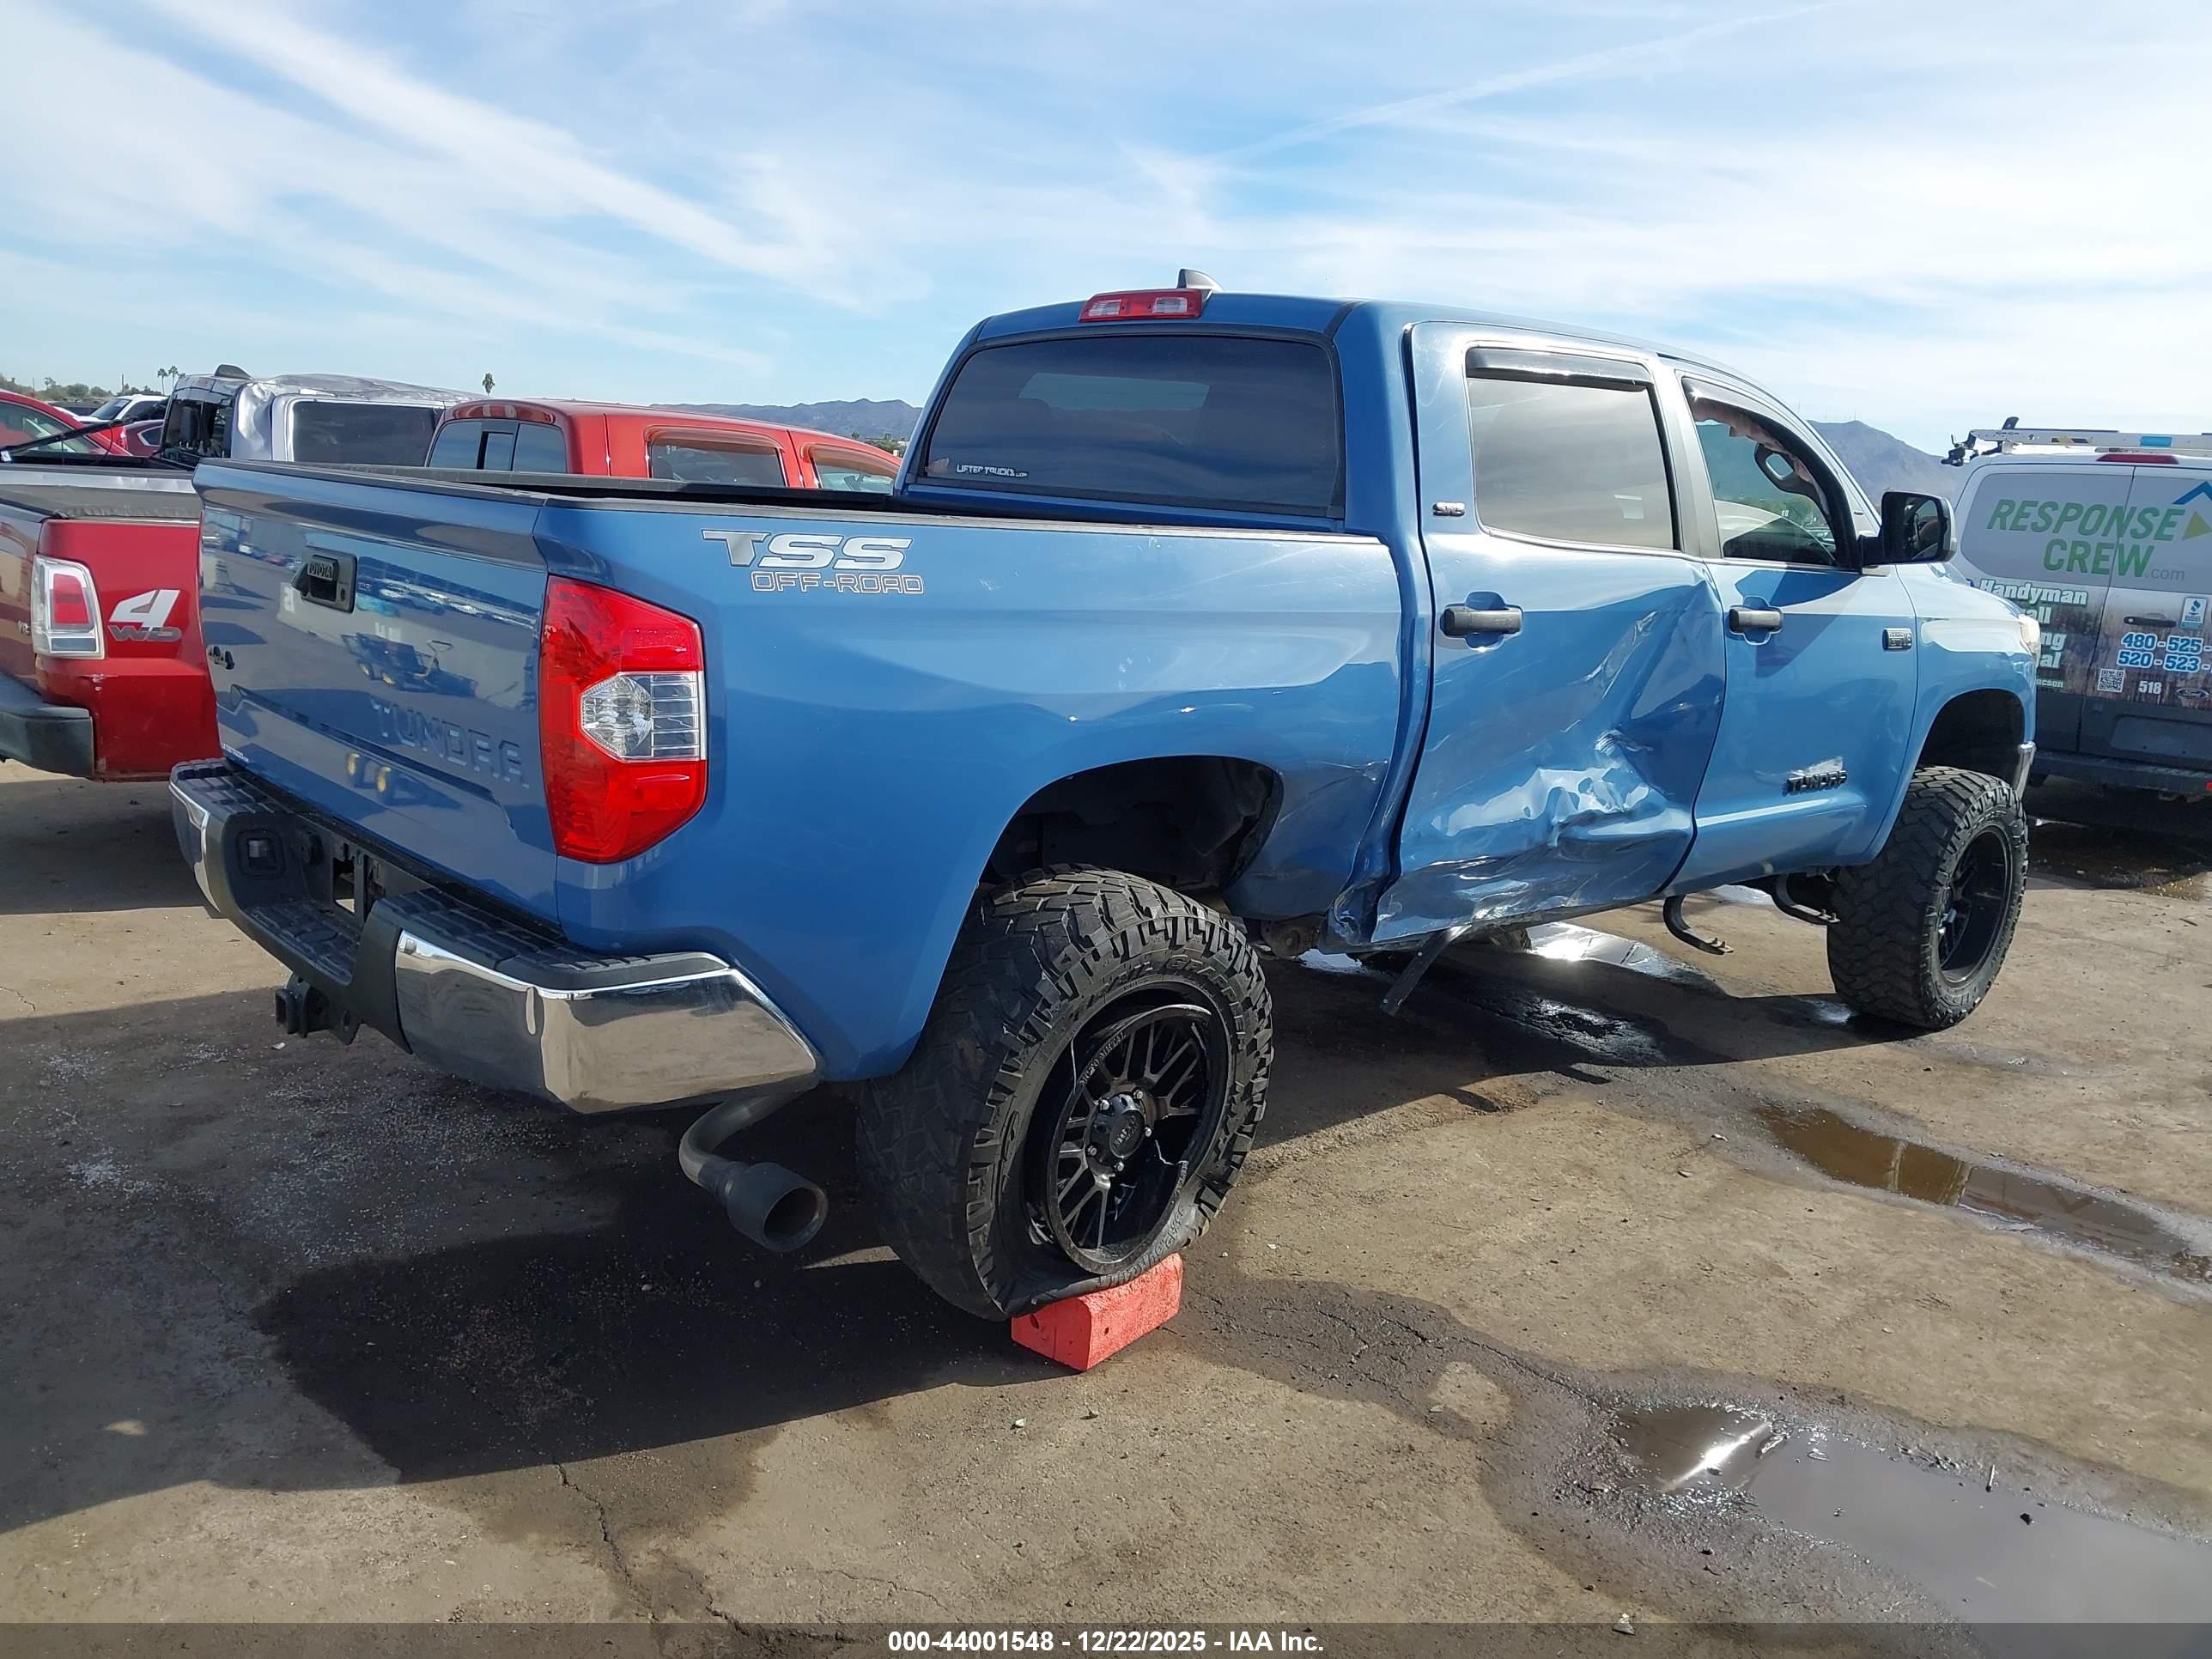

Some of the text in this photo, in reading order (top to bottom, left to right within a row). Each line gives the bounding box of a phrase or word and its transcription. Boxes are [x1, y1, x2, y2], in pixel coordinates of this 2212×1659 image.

[1986, 499, 2185, 541] RESPONSE
[701, 529, 913, 572] TSS
[2043, 538, 2155, 577] CREW
[750, 570, 925, 595] OFF-ROAD
[1979, 579, 2088, 605] Handyman
[2138, 680, 2162, 695] 518
[371, 697, 530, 789] TUNDRA
[1786, 770, 1847, 792] TUNDRA
